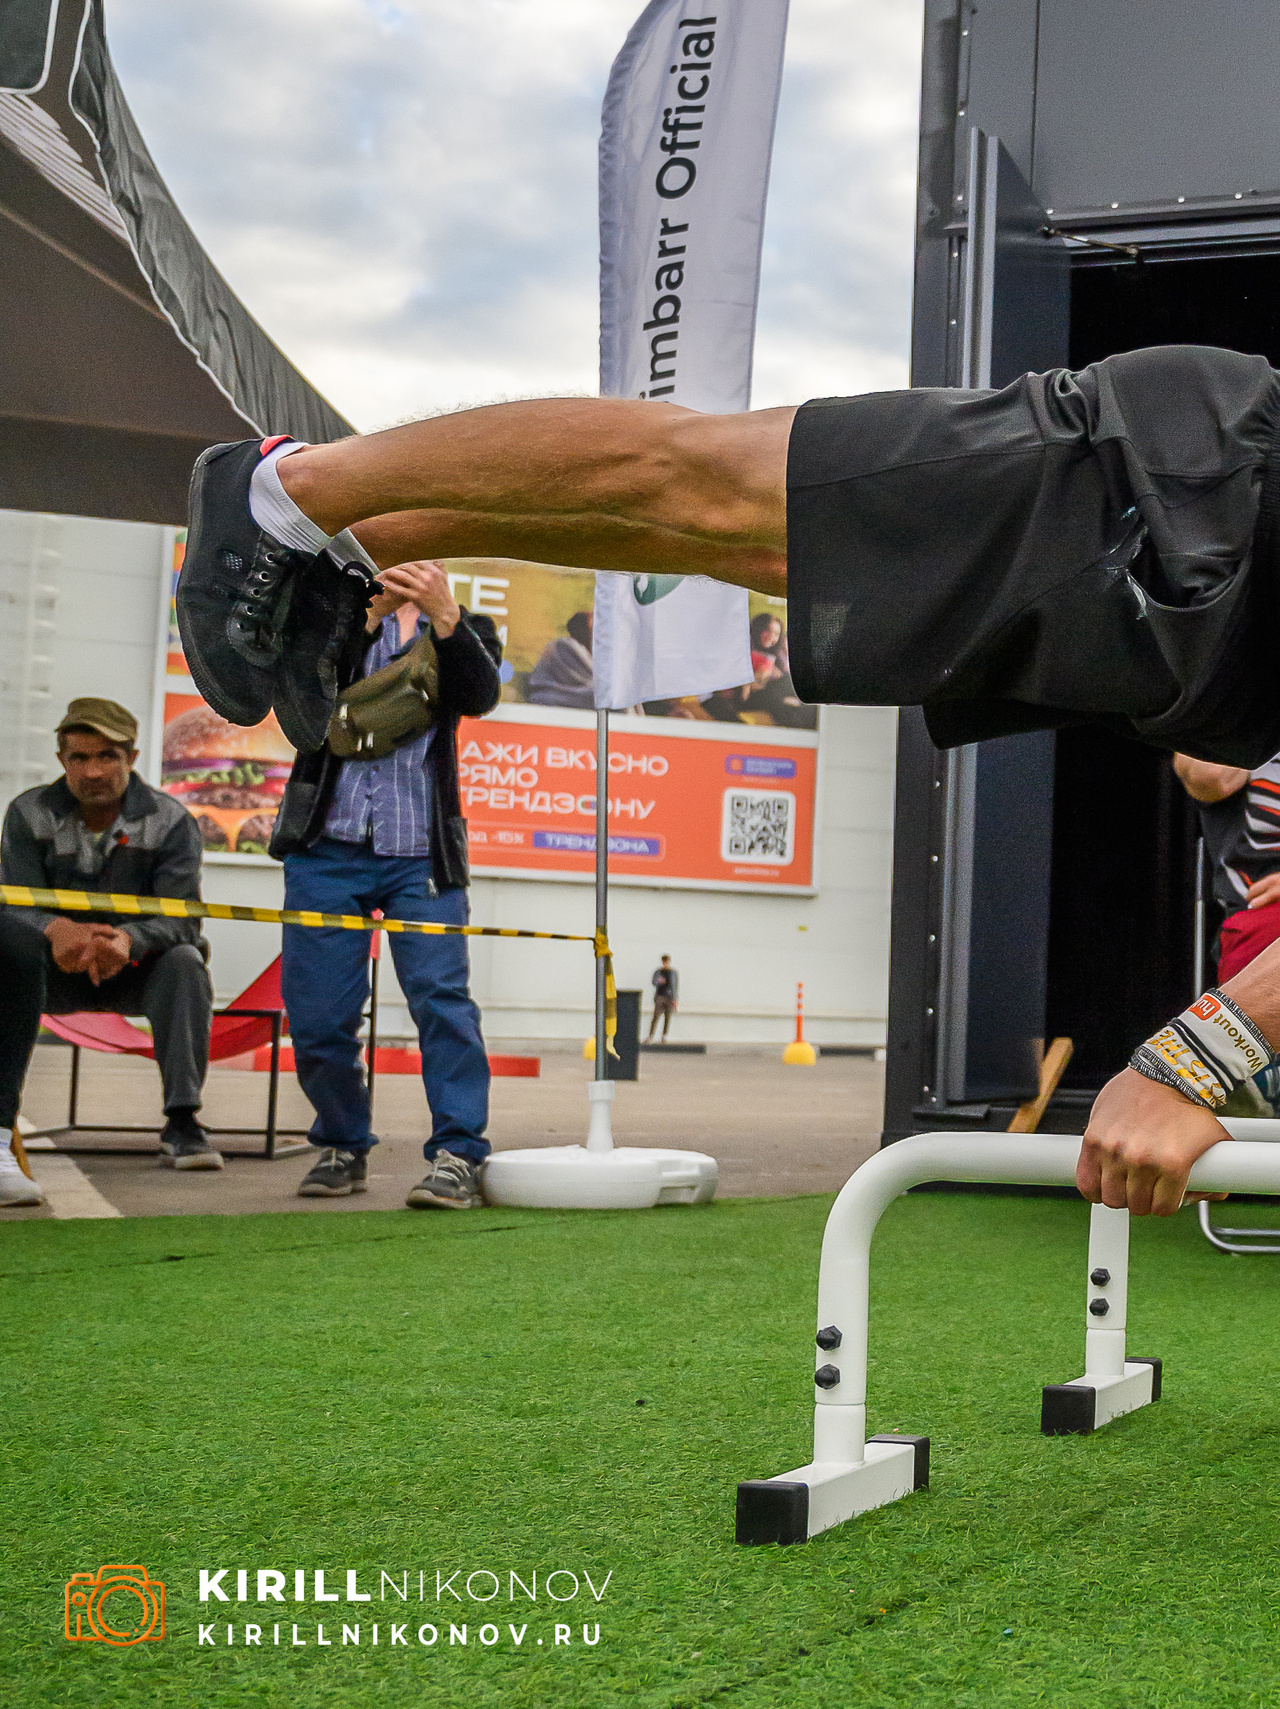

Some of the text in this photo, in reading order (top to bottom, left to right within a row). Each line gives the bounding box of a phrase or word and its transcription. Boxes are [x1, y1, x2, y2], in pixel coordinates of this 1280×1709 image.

[640, 16, 718, 400] imbarr Official
[447, 573, 511, 616] ТЕ
[460, 740, 539, 767] АЖИ
[458, 762, 539, 789] РЯМО
[459, 785, 657, 820] РЕНДЗОНУ
[1212, 1014, 1263, 1072] Workout
